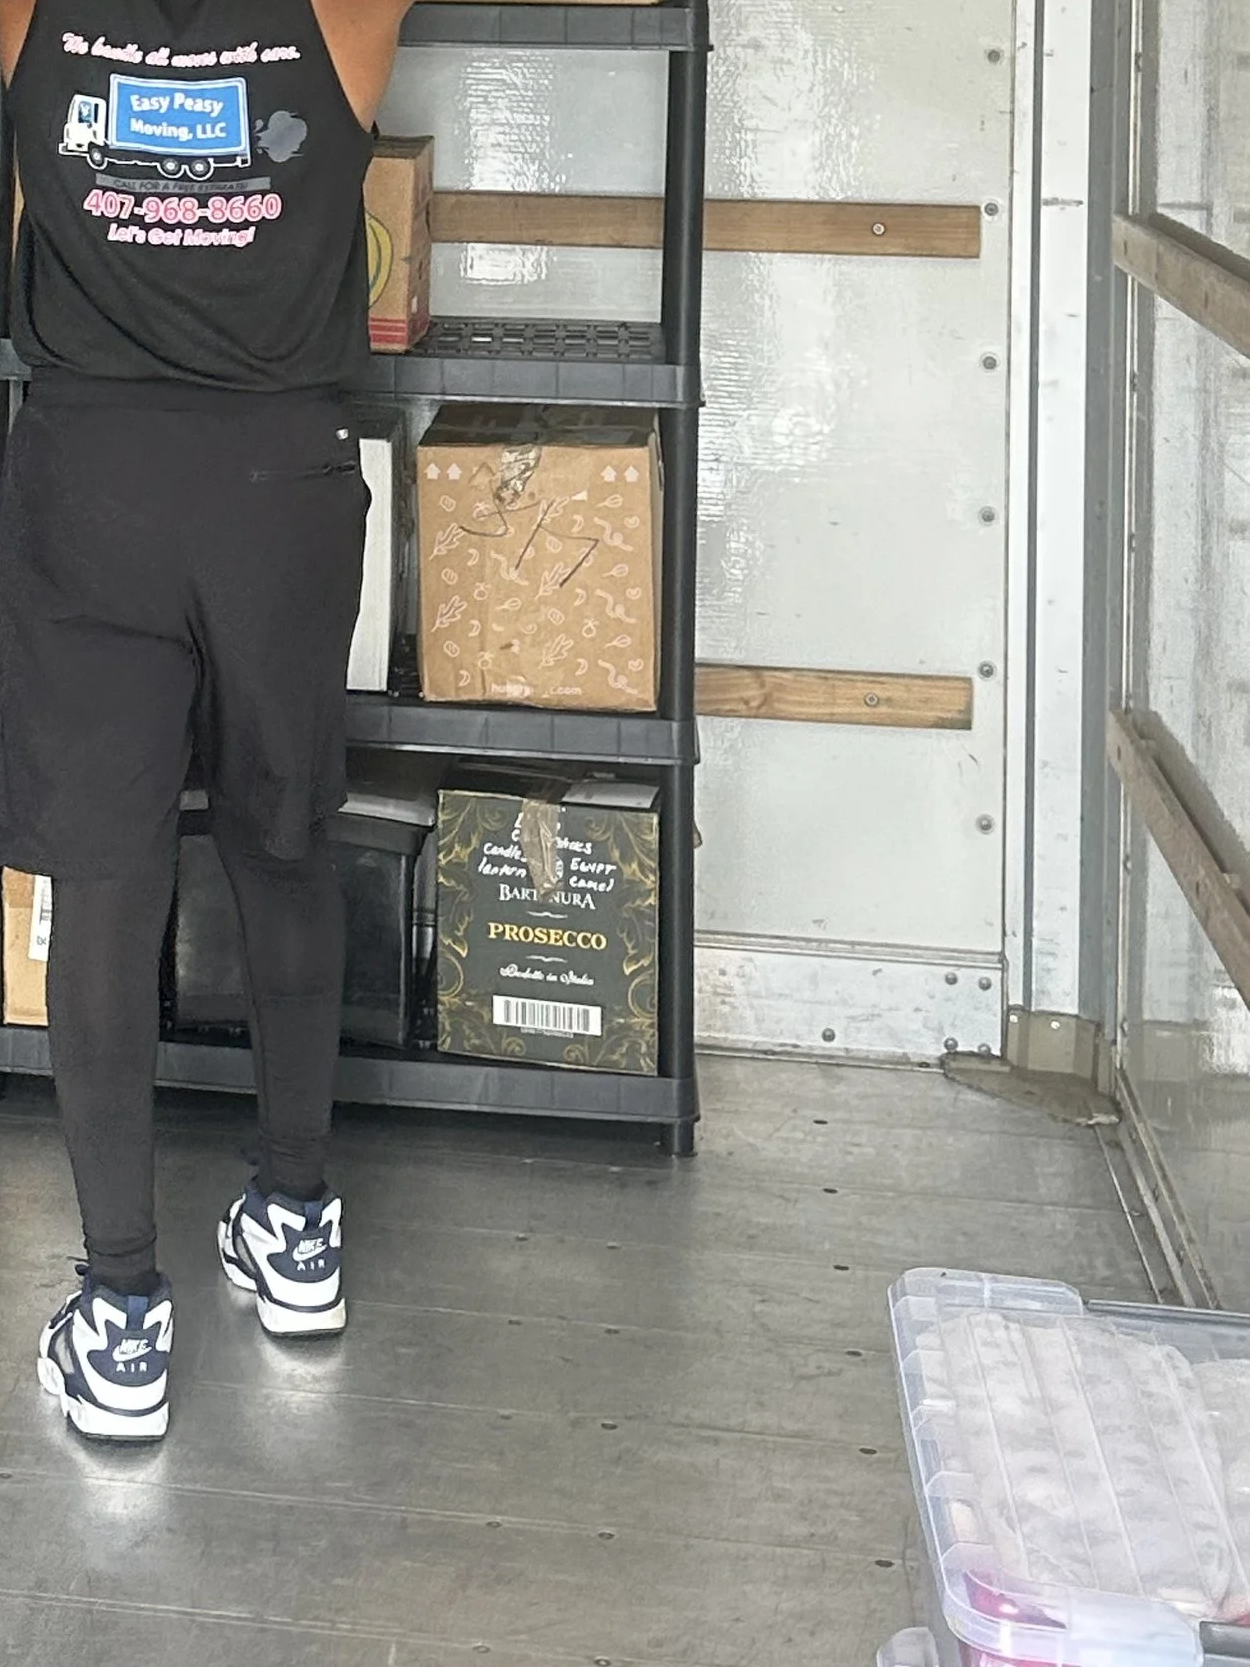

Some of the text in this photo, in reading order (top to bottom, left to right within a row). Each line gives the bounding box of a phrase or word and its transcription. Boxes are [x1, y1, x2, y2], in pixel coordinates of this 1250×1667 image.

[220, 41, 258, 65] with
[130, 92, 223, 116] Easy Peasy
[130, 118, 226, 142] Moving, LLC
[139, 181, 160, 191] FOR
[162, 182, 170, 191] A
[83, 189, 282, 224] 407-968-8660
[107, 223, 256, 248] Let's Get Moving!
[499, 883, 596, 910] BARTNURA
[487, 921, 608, 951] PROSECCO
[297, 1237, 324, 1254] NIKE
[296, 1259, 325, 1271] AIR
[119, 1338, 149, 1355] NIKE
[116, 1361, 148, 1373] AIR
